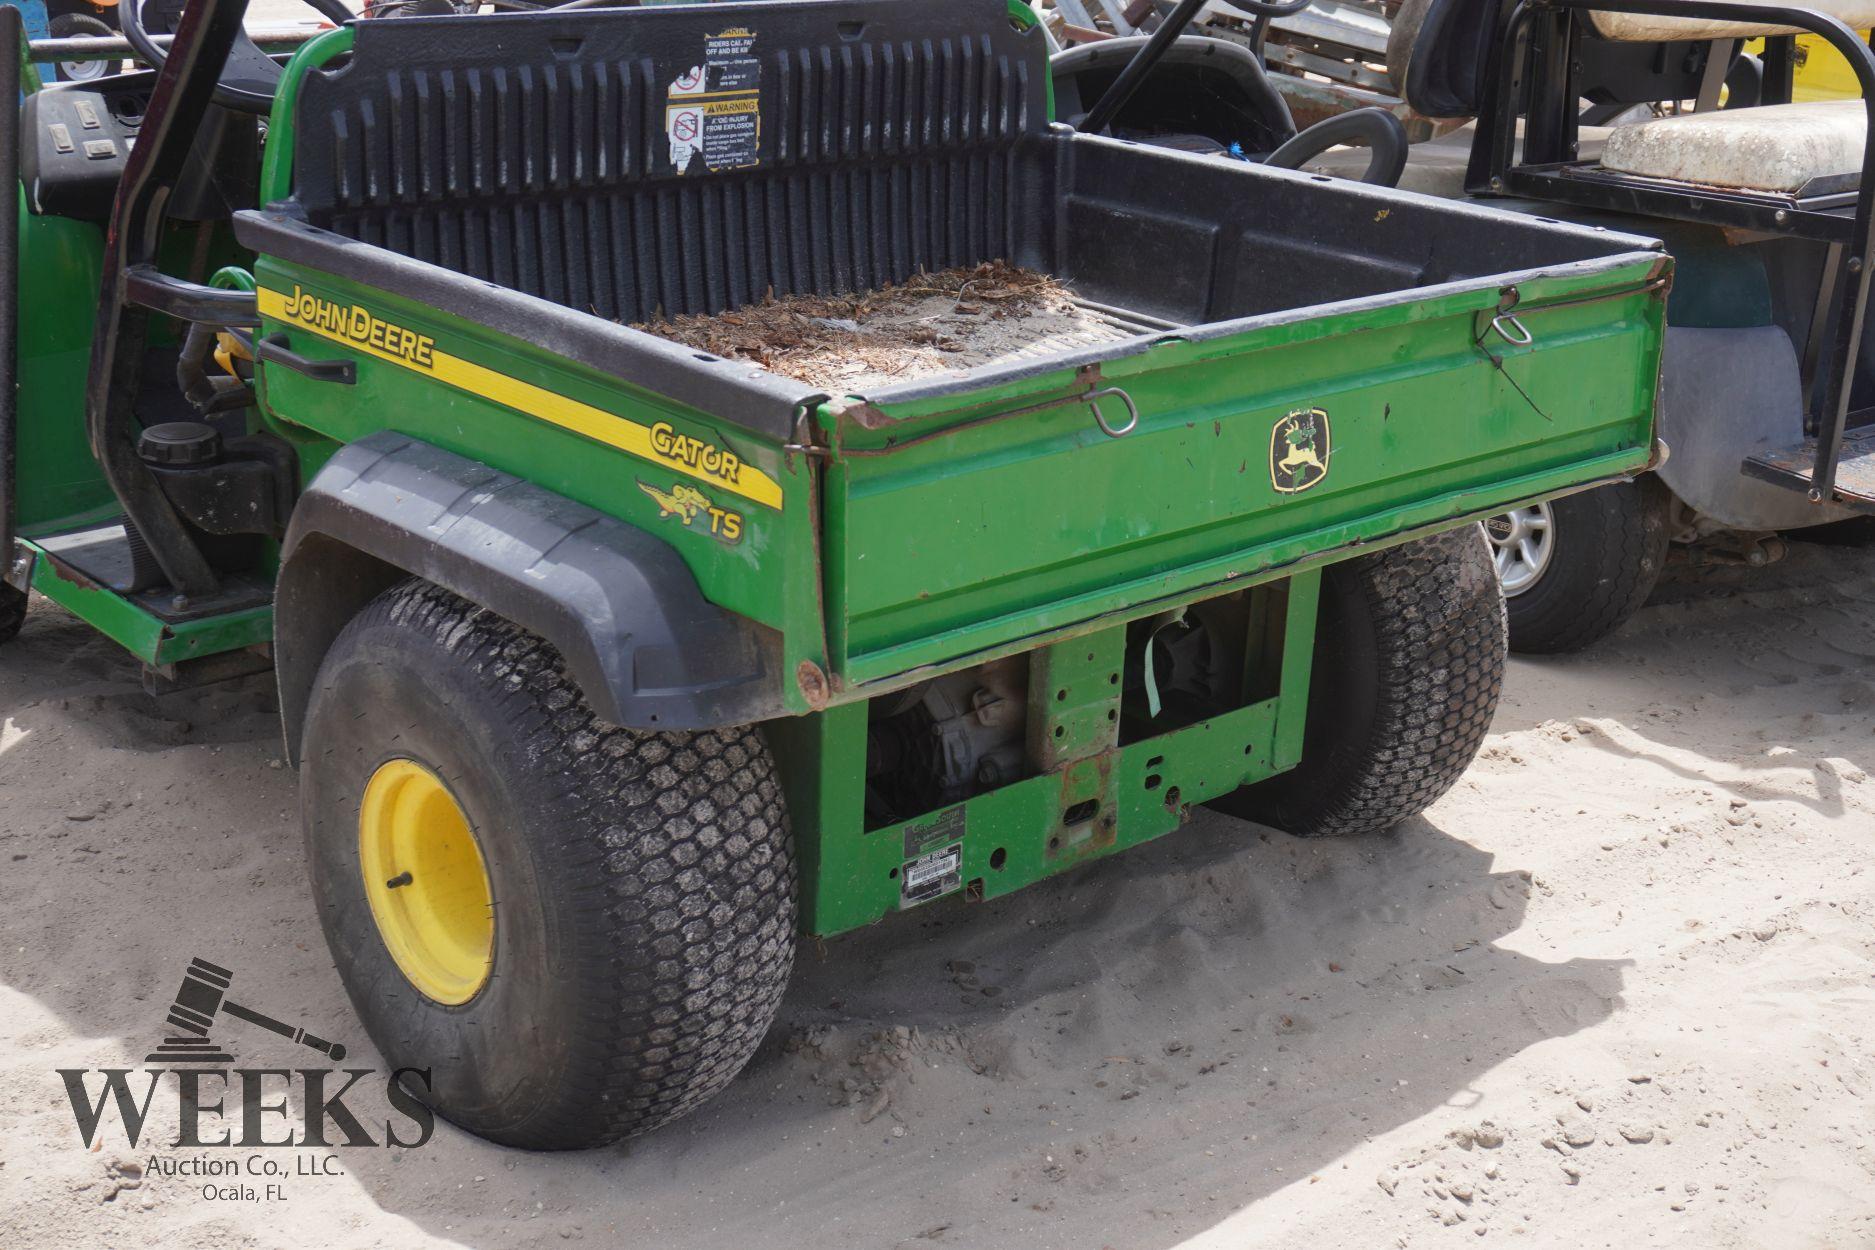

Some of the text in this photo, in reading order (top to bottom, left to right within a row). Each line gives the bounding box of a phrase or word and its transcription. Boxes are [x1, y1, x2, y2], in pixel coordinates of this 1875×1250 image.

[715, 102, 755, 112] WARNING
[723, 122, 754, 130] EXPLOSION
[285, 285, 435, 368] JOHN DEERE
[650, 421, 739, 484] GATOR
[707, 505, 743, 540] TS
